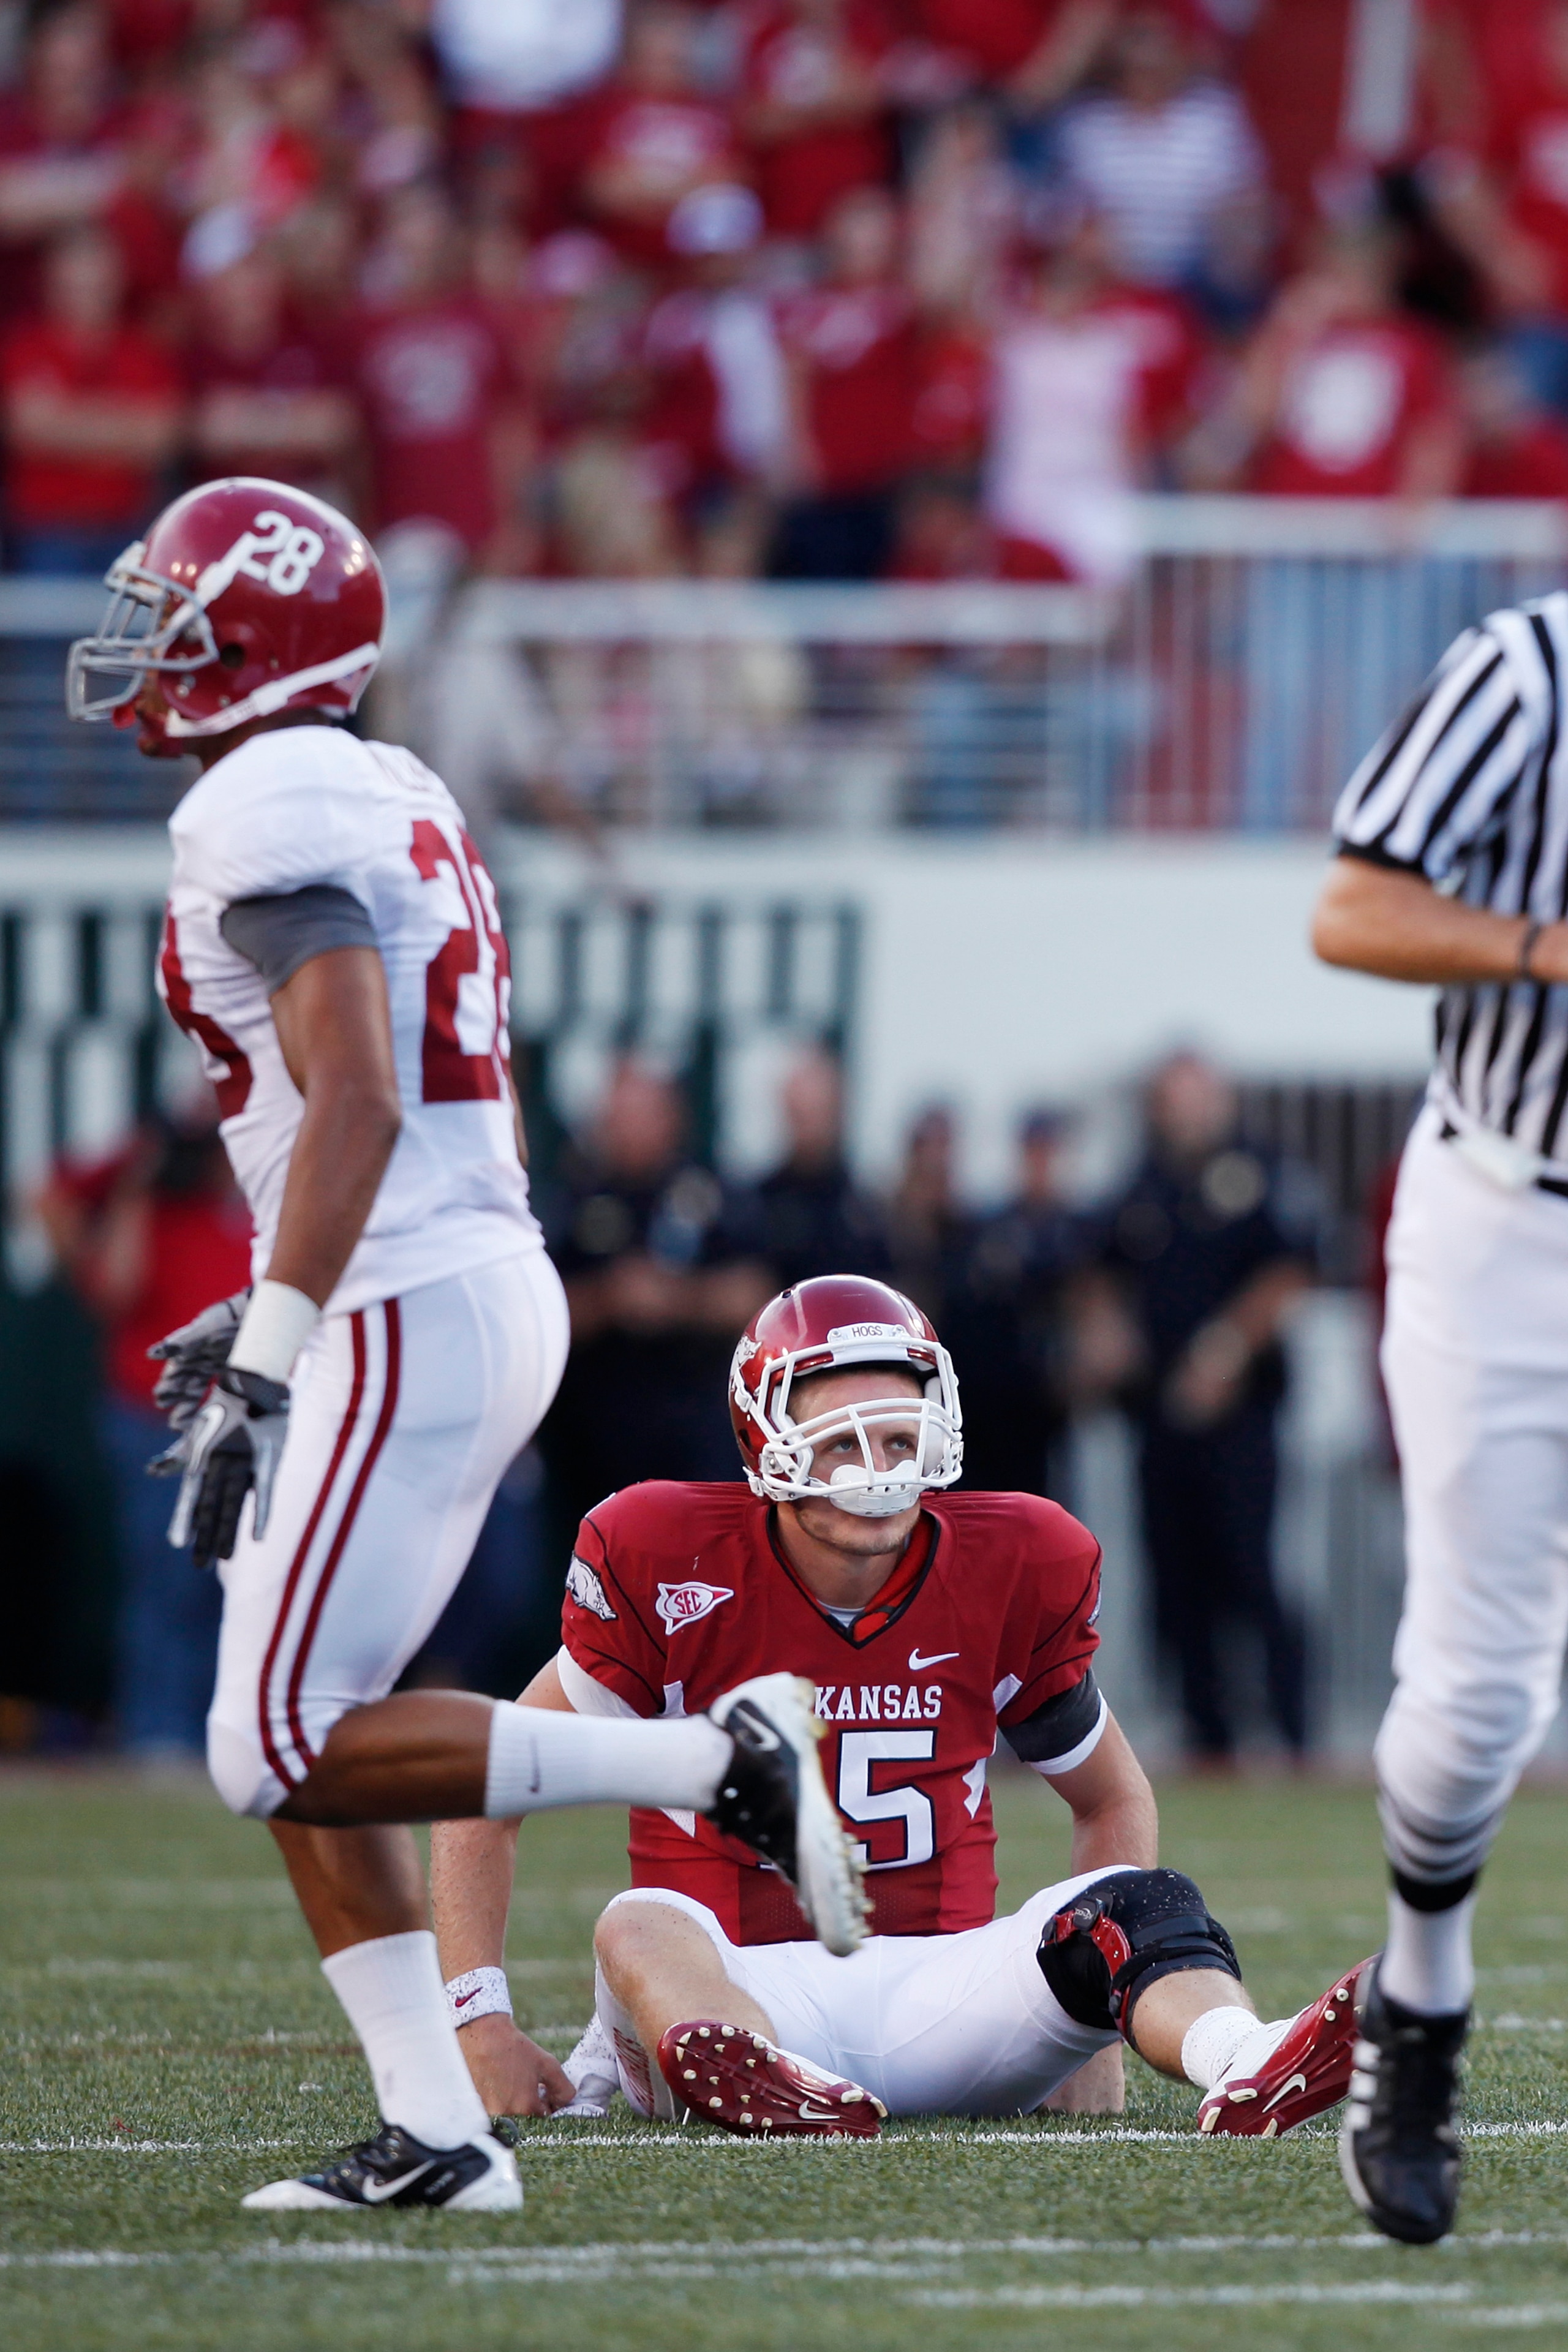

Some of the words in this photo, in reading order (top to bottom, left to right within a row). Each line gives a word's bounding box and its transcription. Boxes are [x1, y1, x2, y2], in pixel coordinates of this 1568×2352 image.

[239, 510, 325, 596] 28
[852, 1325, 883, 1338] HOGS
[674, 1589, 702, 1616] SEC
[813, 1684, 943, 1720] KANSAS
[837, 1727, 938, 1872] 5
